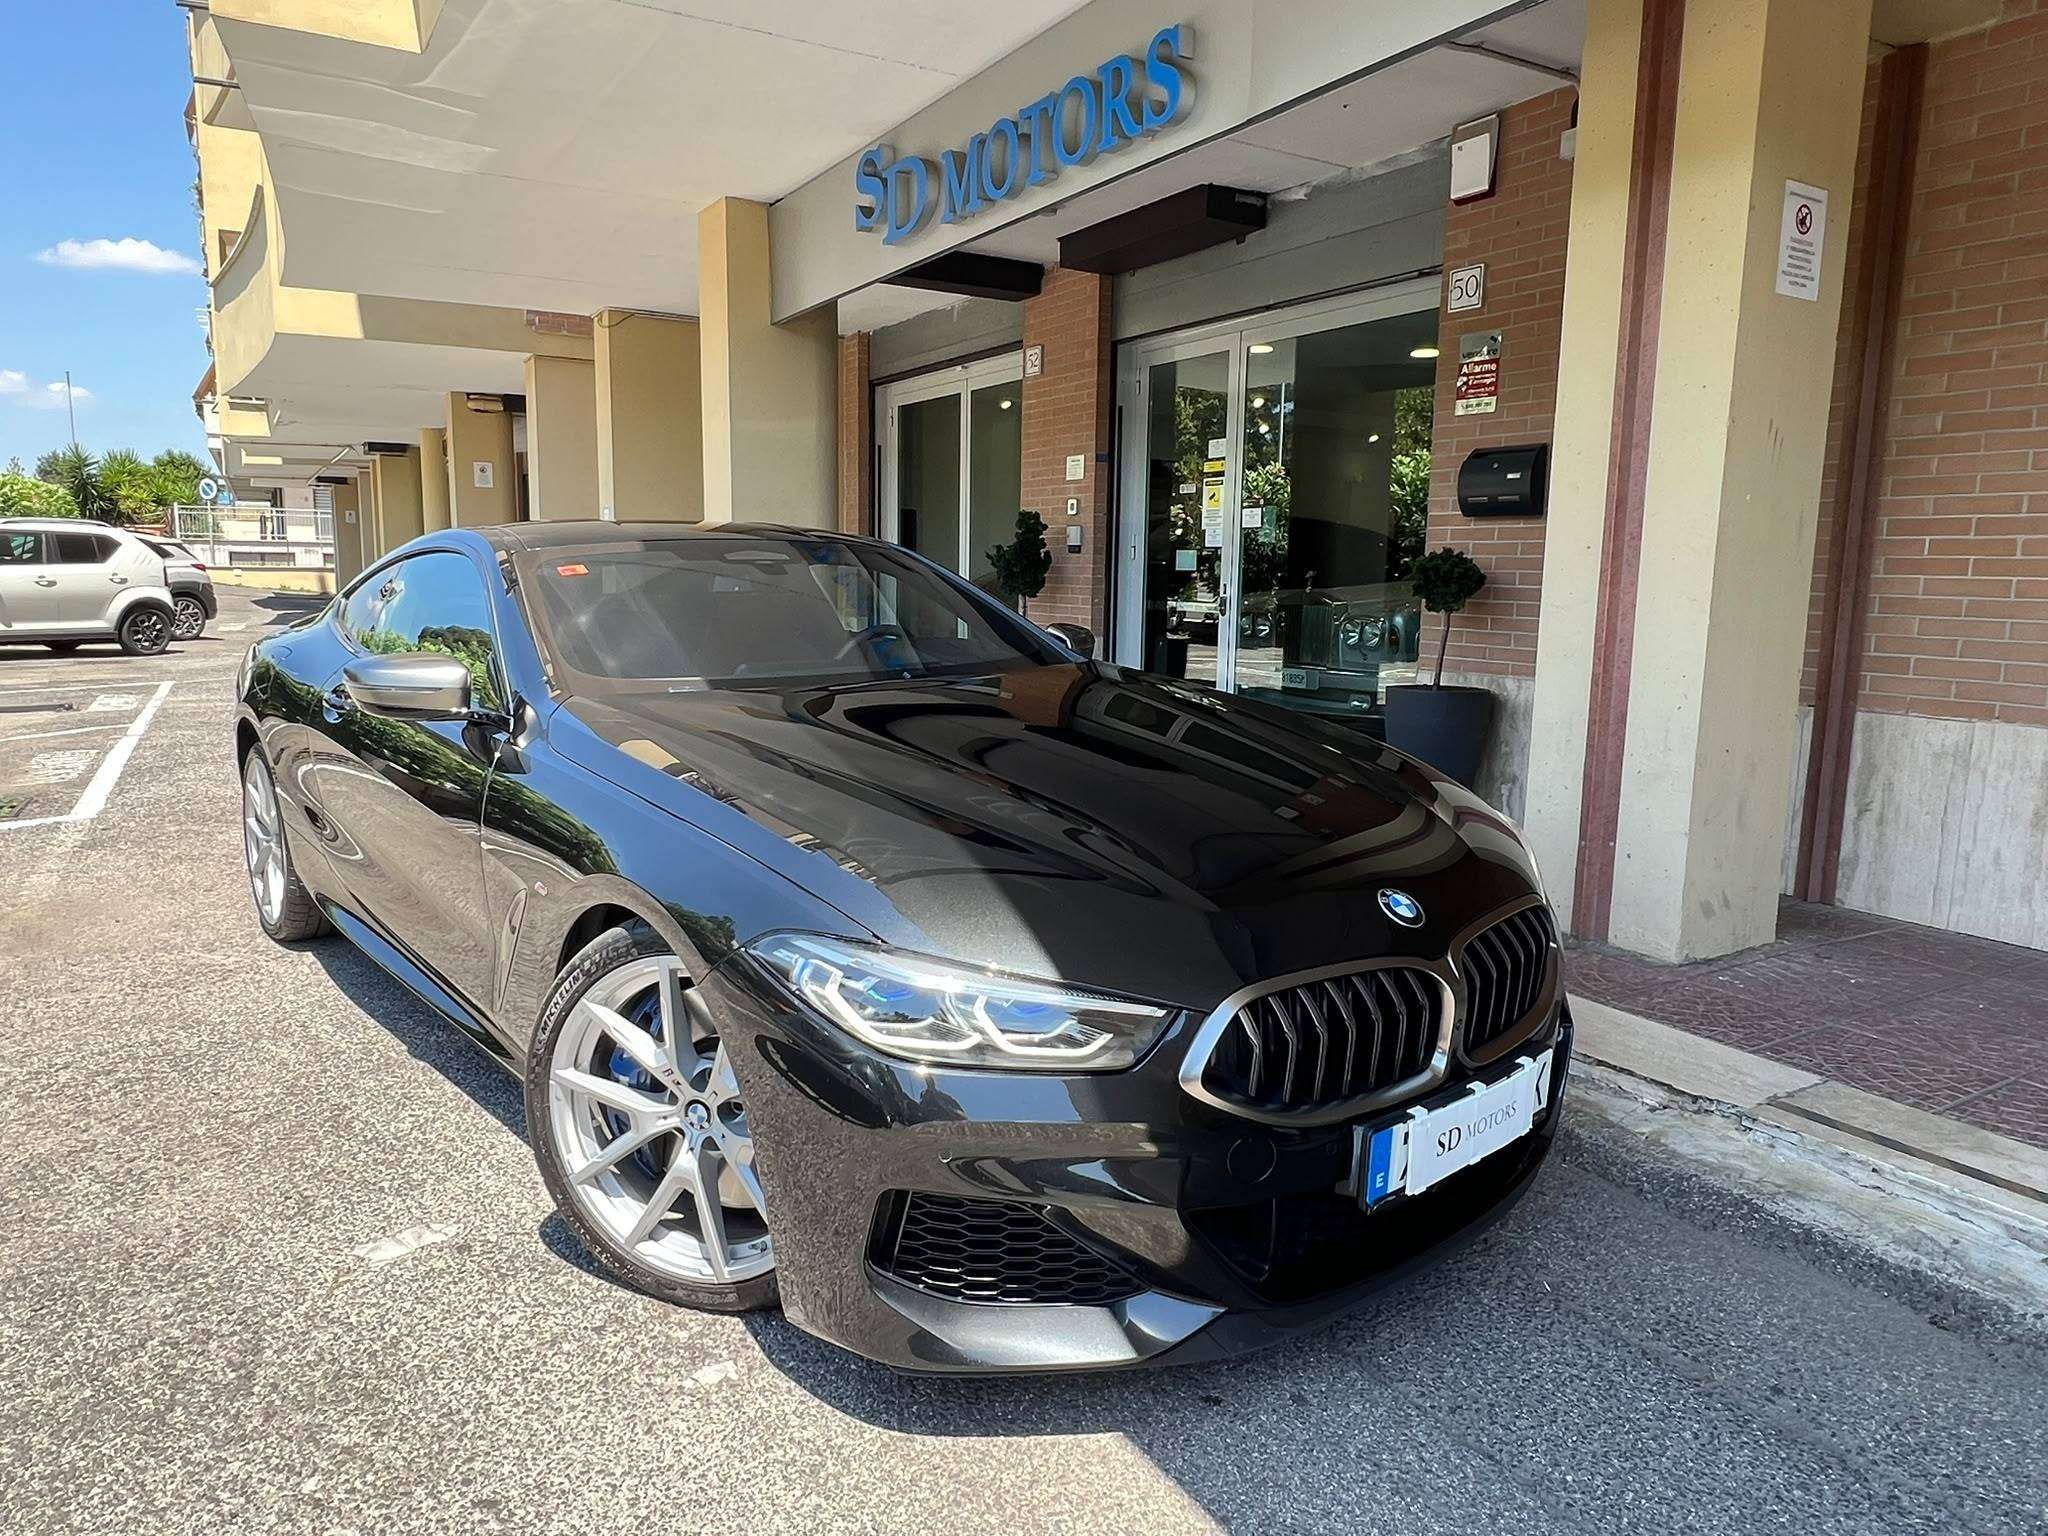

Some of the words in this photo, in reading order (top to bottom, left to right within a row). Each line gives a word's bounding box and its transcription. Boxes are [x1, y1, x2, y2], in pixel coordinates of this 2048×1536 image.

[856, 143, 938, 247] SD
[940, 23, 1195, 225] MOTORS
[1452, 274, 1479, 301] 50
[1027, 351, 1040, 369] 52
[540, 968, 583, 1036] MICHELIN
[1436, 1126, 1461, 1157] SD
[1466, 1101, 1516, 1140] MOTORS
[1375, 1172, 1385, 1189] E
